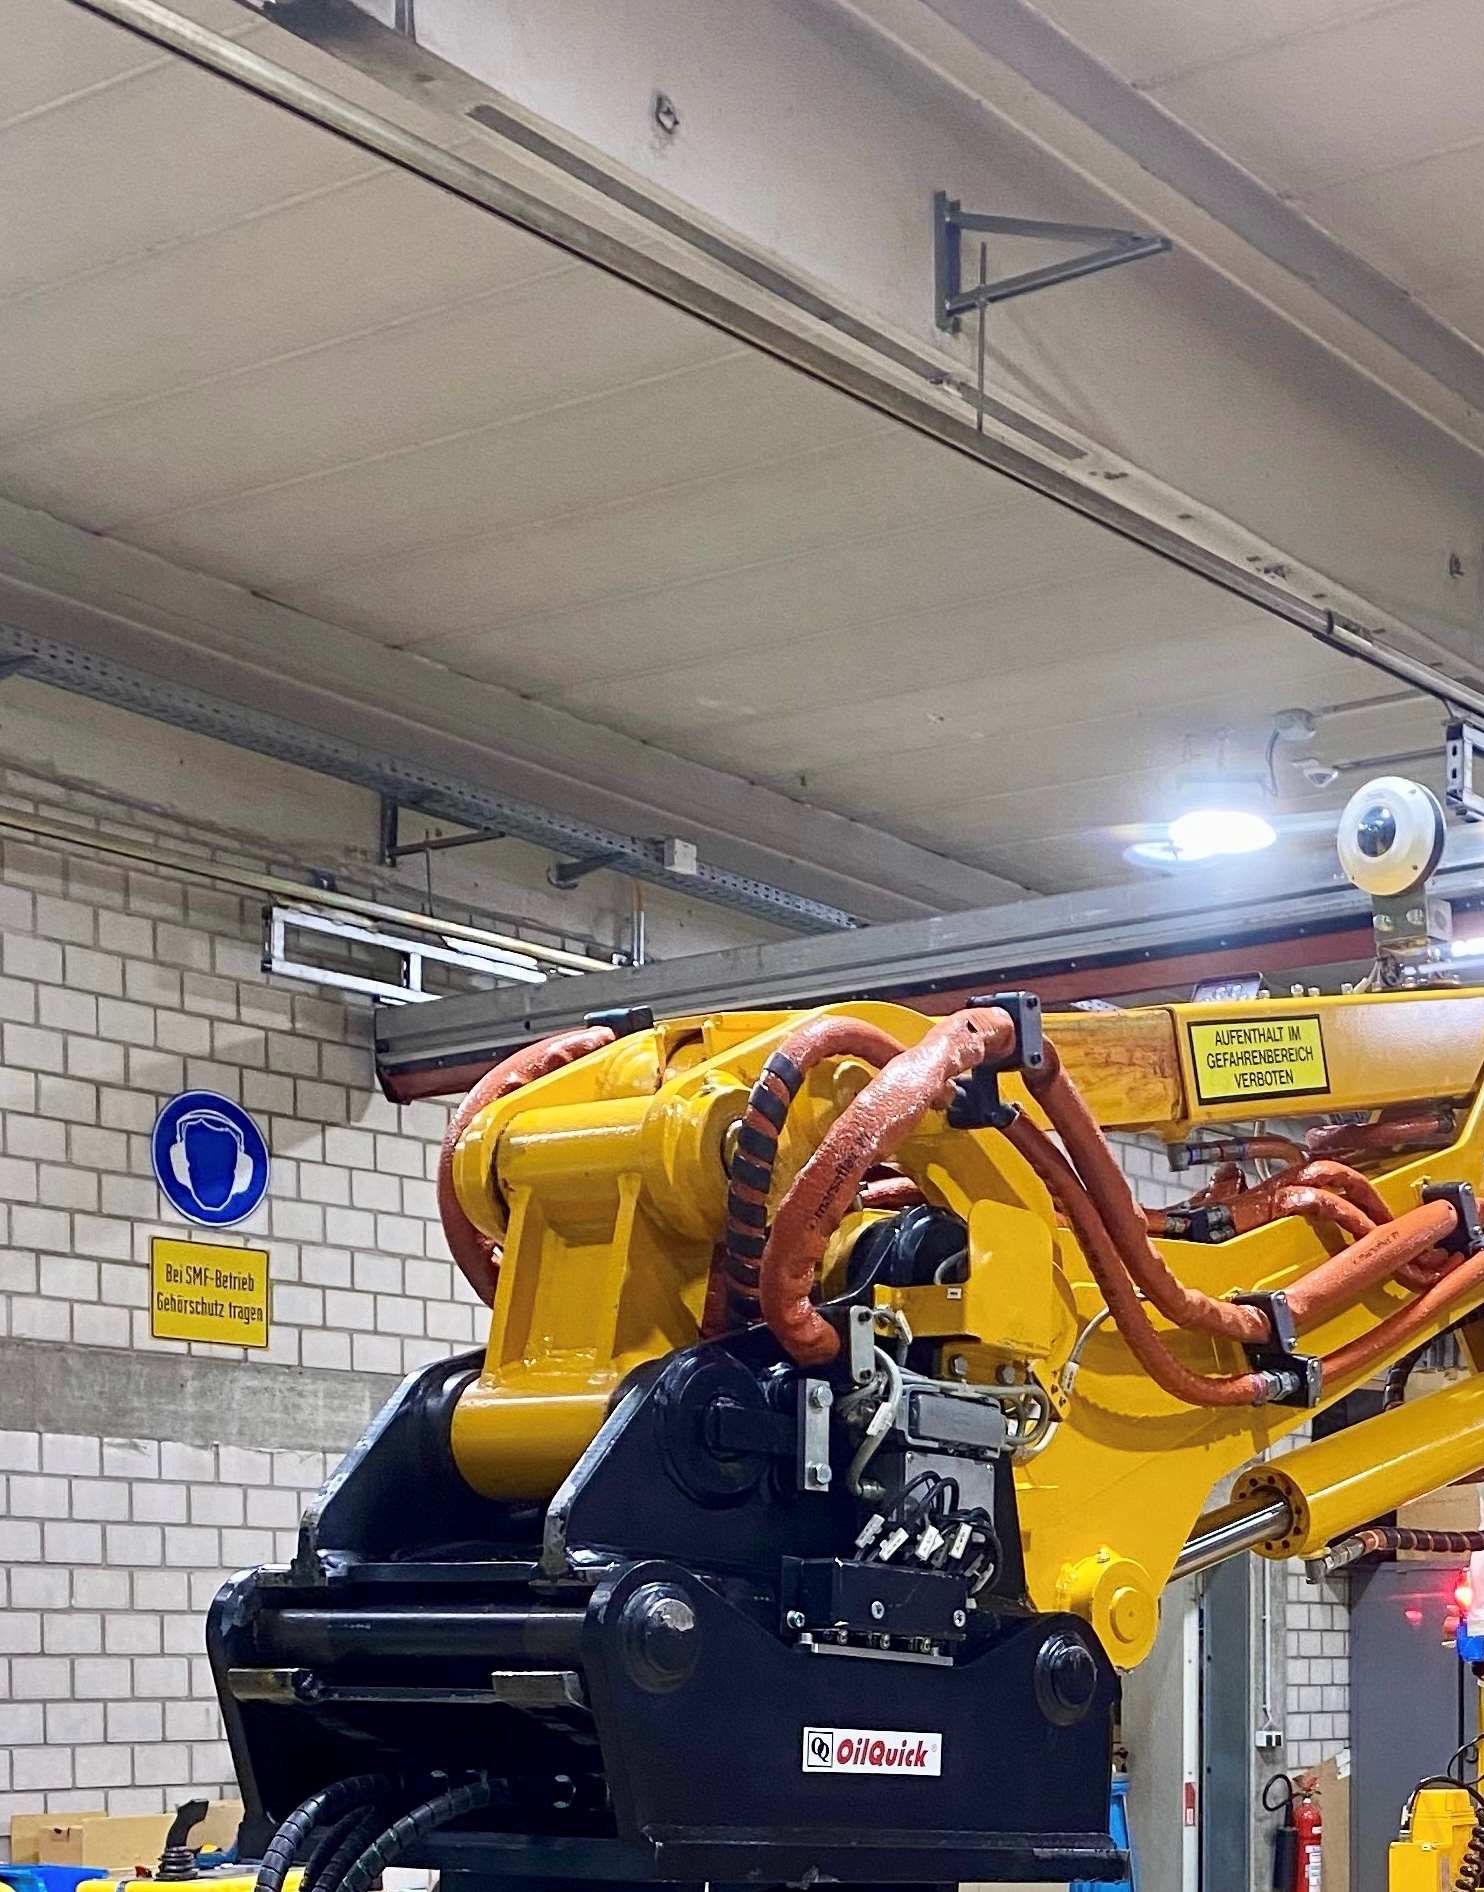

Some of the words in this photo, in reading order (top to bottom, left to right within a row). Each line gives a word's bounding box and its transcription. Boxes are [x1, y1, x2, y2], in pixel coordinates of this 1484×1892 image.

[1215, 1026, 1283, 1046] AUFENTHALT
[1288, 1025, 1302, 1041] IM
[1206, 1046, 1314, 1069] GEFAHRENBEREICH
[1234, 1069, 1294, 1088] VERBOTEN
[165, 1263, 183, 1284] Bei
[185, 1265, 255, 1292] SMF-Betrieb
[156, 1291, 225, 1318] Gehörschutz
[228, 1301, 263, 1325] tragen
[836, 1737, 929, 1767] OilQuick
